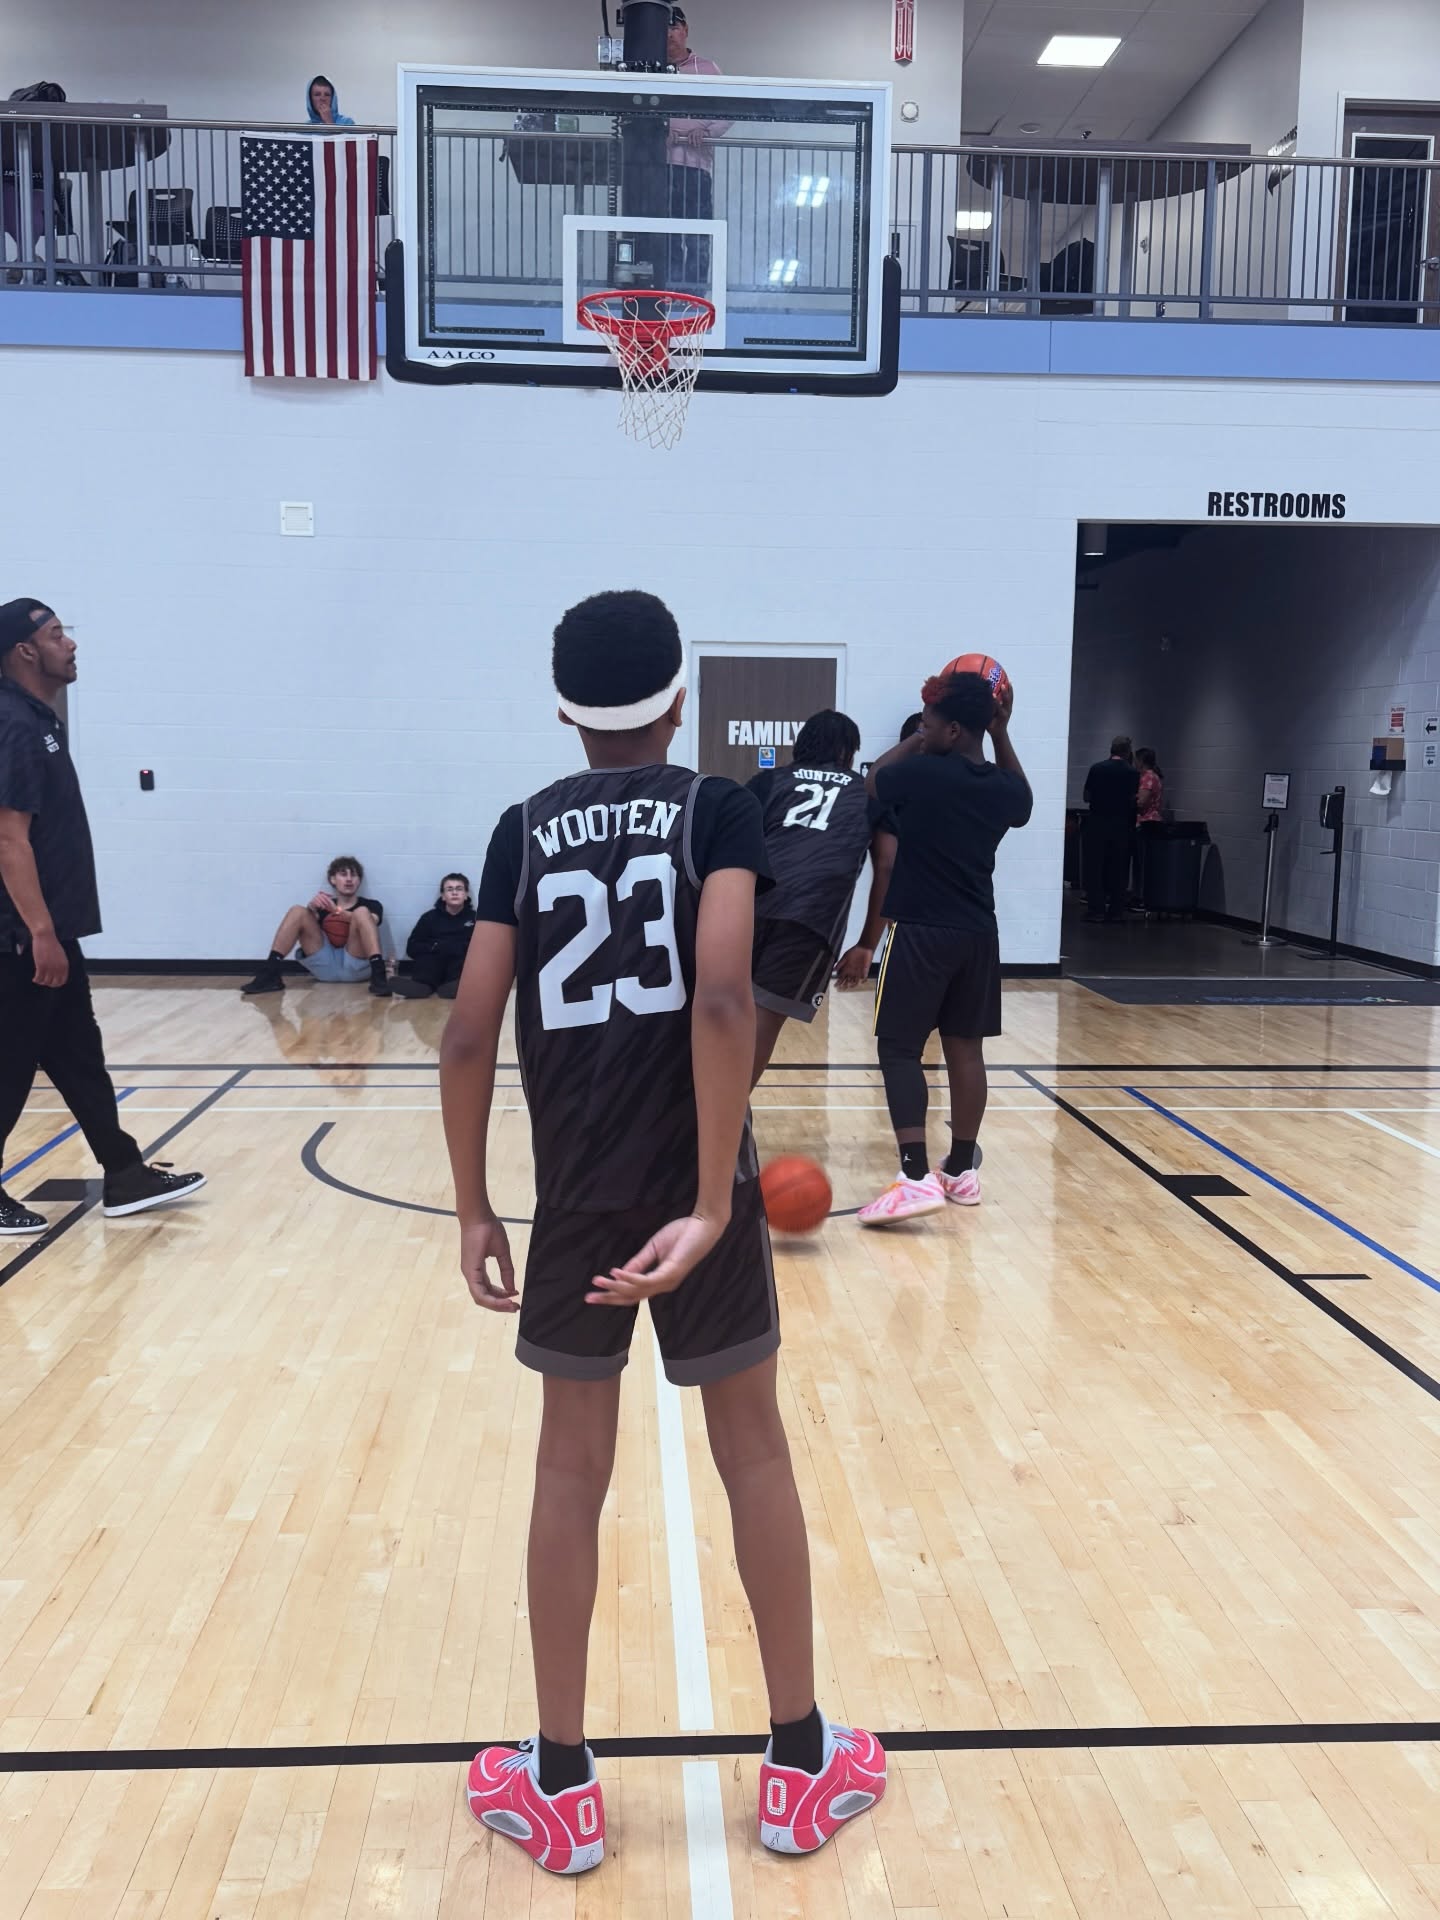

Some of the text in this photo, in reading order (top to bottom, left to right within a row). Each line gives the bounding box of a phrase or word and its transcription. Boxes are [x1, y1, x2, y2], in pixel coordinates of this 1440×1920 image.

[427, 350, 495, 360] AALCO
[1208, 491, 1346, 519] RESTROOMS
[782, 783, 841, 831] 21
[532, 798, 682, 858] WOOTEN
[536, 852, 686, 1031] 23
[577, 1796, 598, 1836] 0
[767, 1777, 787, 1816] 0
